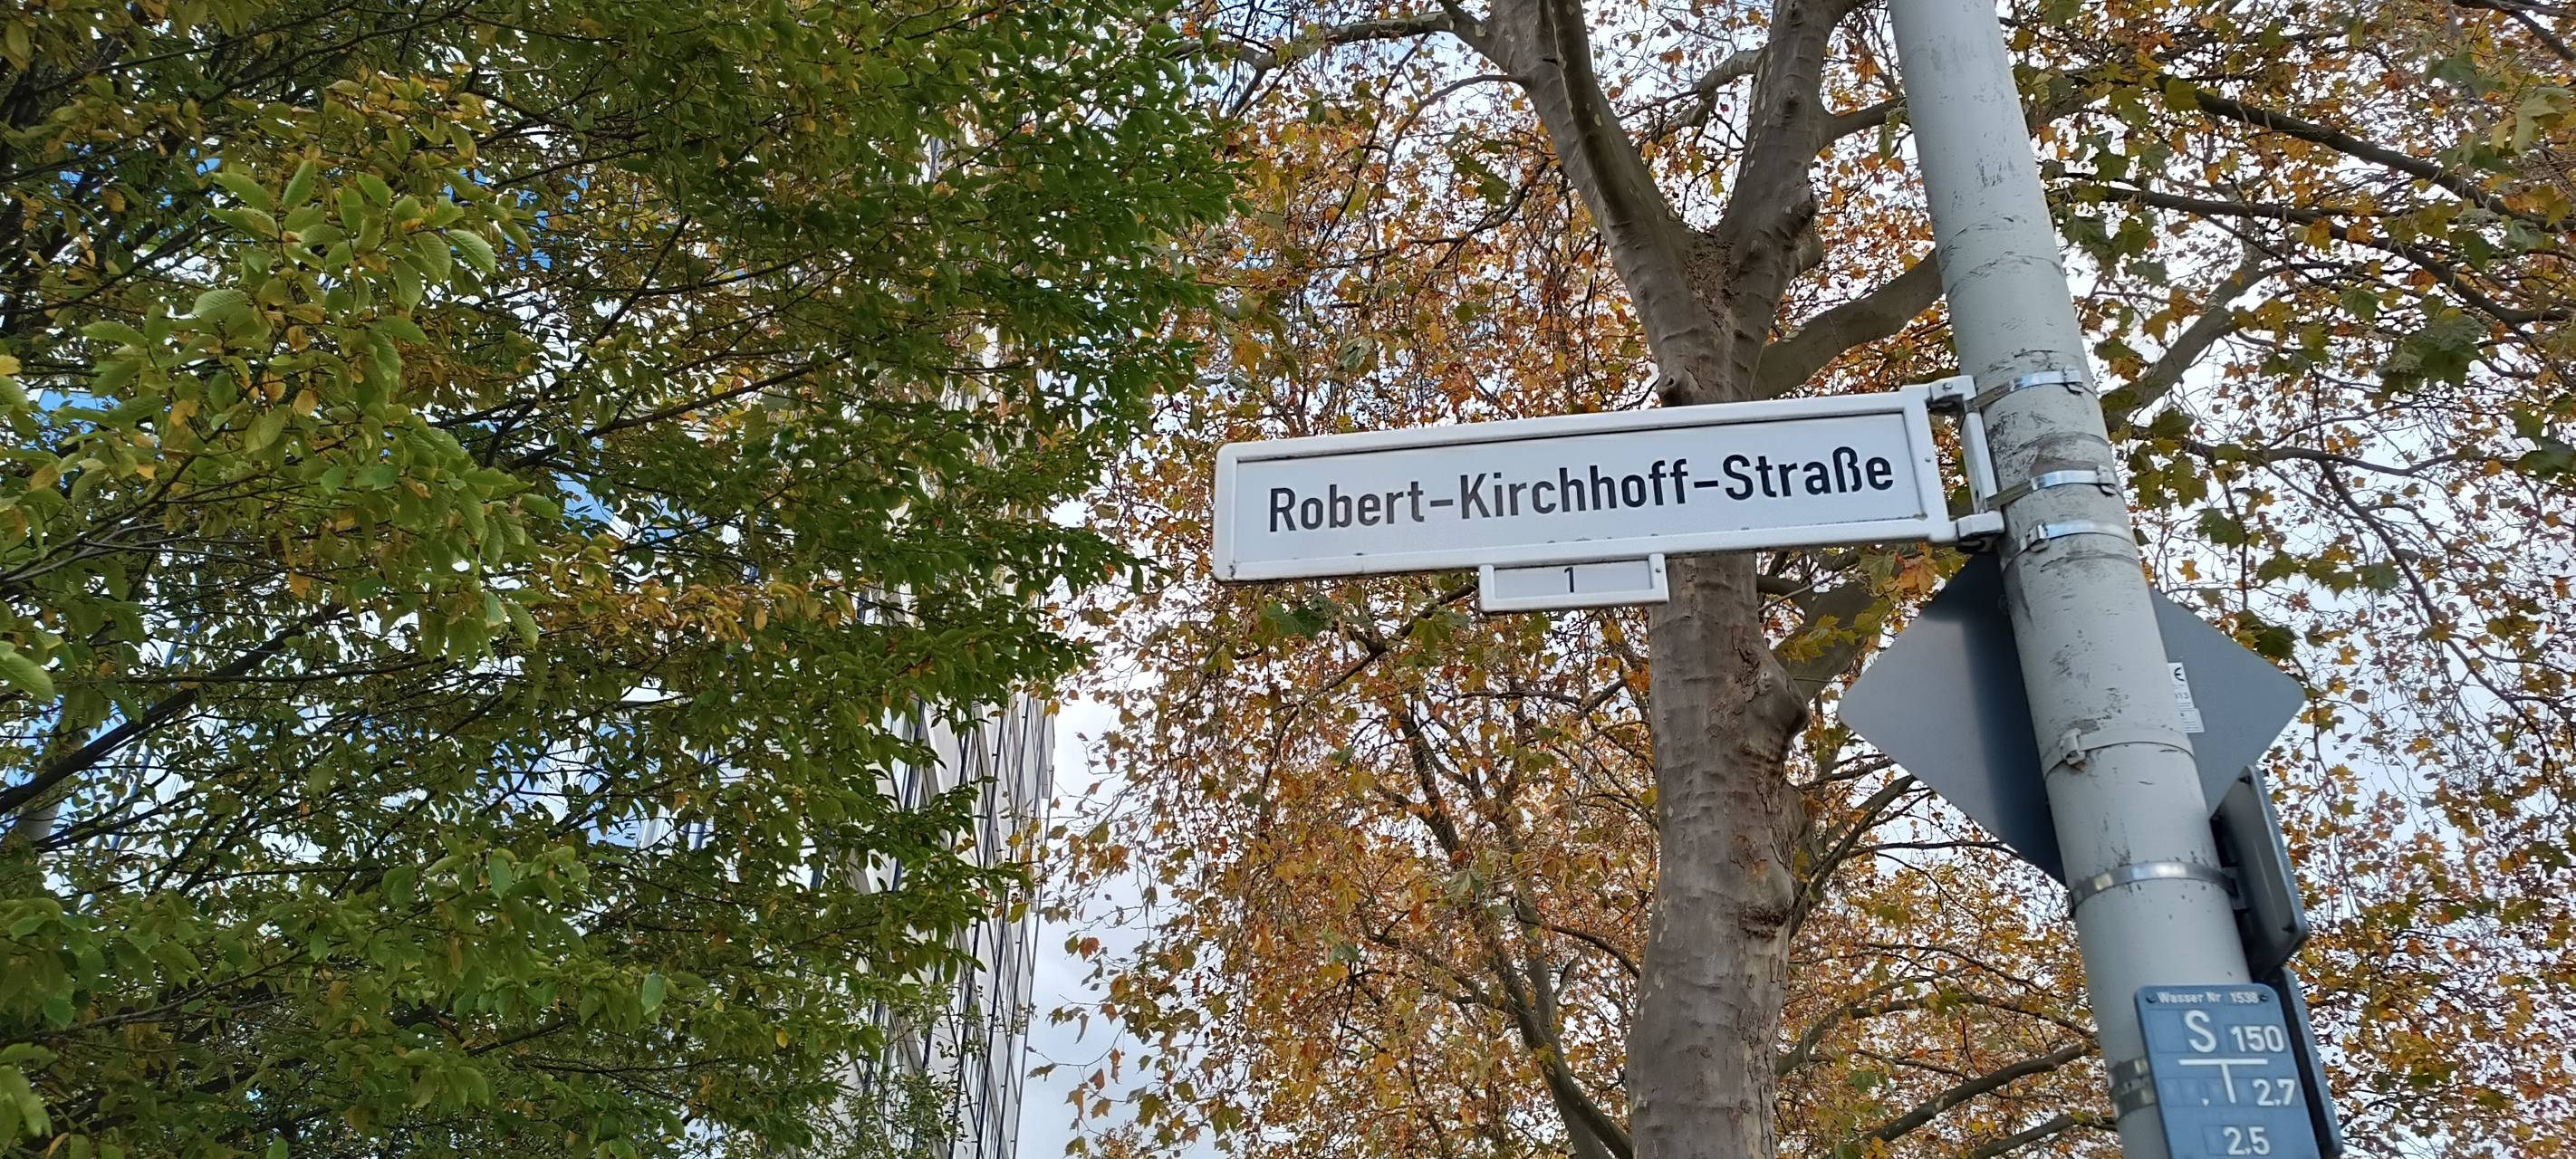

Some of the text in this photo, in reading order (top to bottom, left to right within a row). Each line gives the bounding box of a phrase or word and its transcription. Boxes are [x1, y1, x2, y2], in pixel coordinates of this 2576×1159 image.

[1269, 445, 1895, 532] Robert-Kirchhoff-Straße
[1564, 566, 1574, 593] 1
[2157, 991, 2204, 1003] Wasser
[2184, 1010, 2284, 1053] S 150
